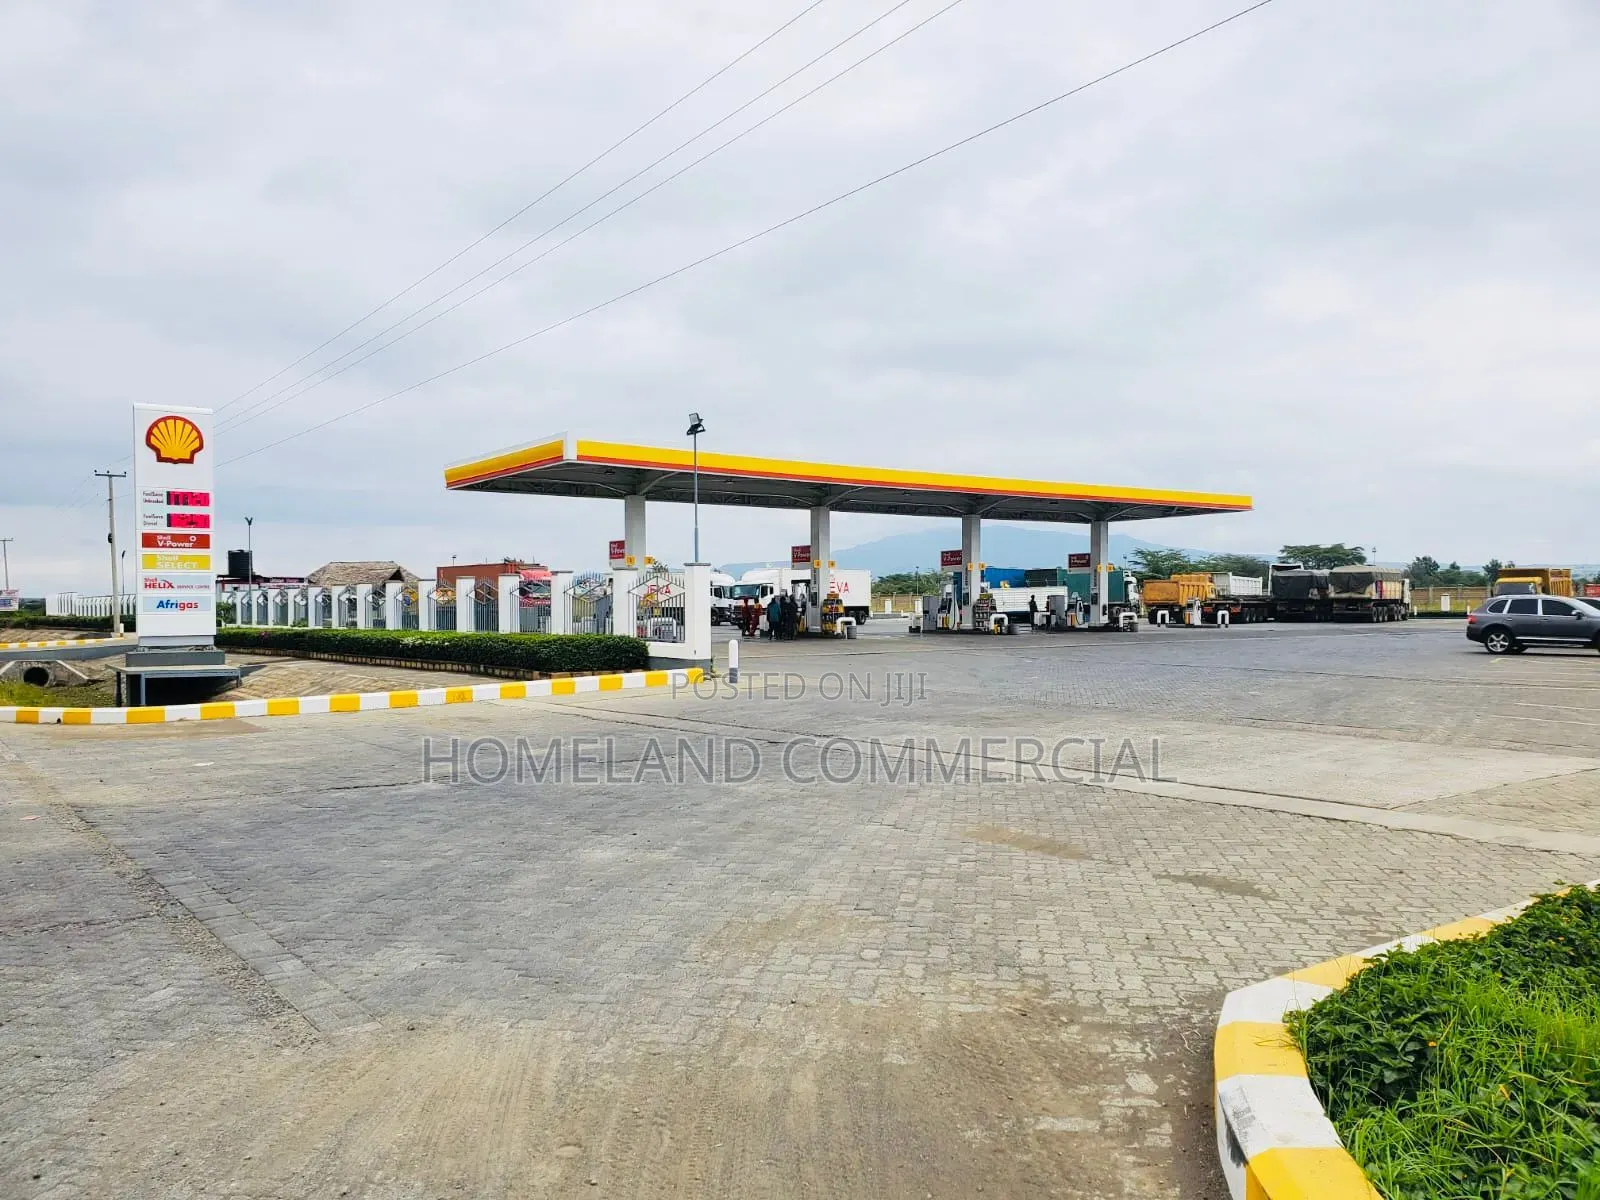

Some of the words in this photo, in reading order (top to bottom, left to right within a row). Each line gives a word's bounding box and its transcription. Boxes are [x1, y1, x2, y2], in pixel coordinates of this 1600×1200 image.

[157, 540, 193, 548] V-Power
[156, 561, 198, 569] SELECT
[156, 599, 199, 611] Afrigas
